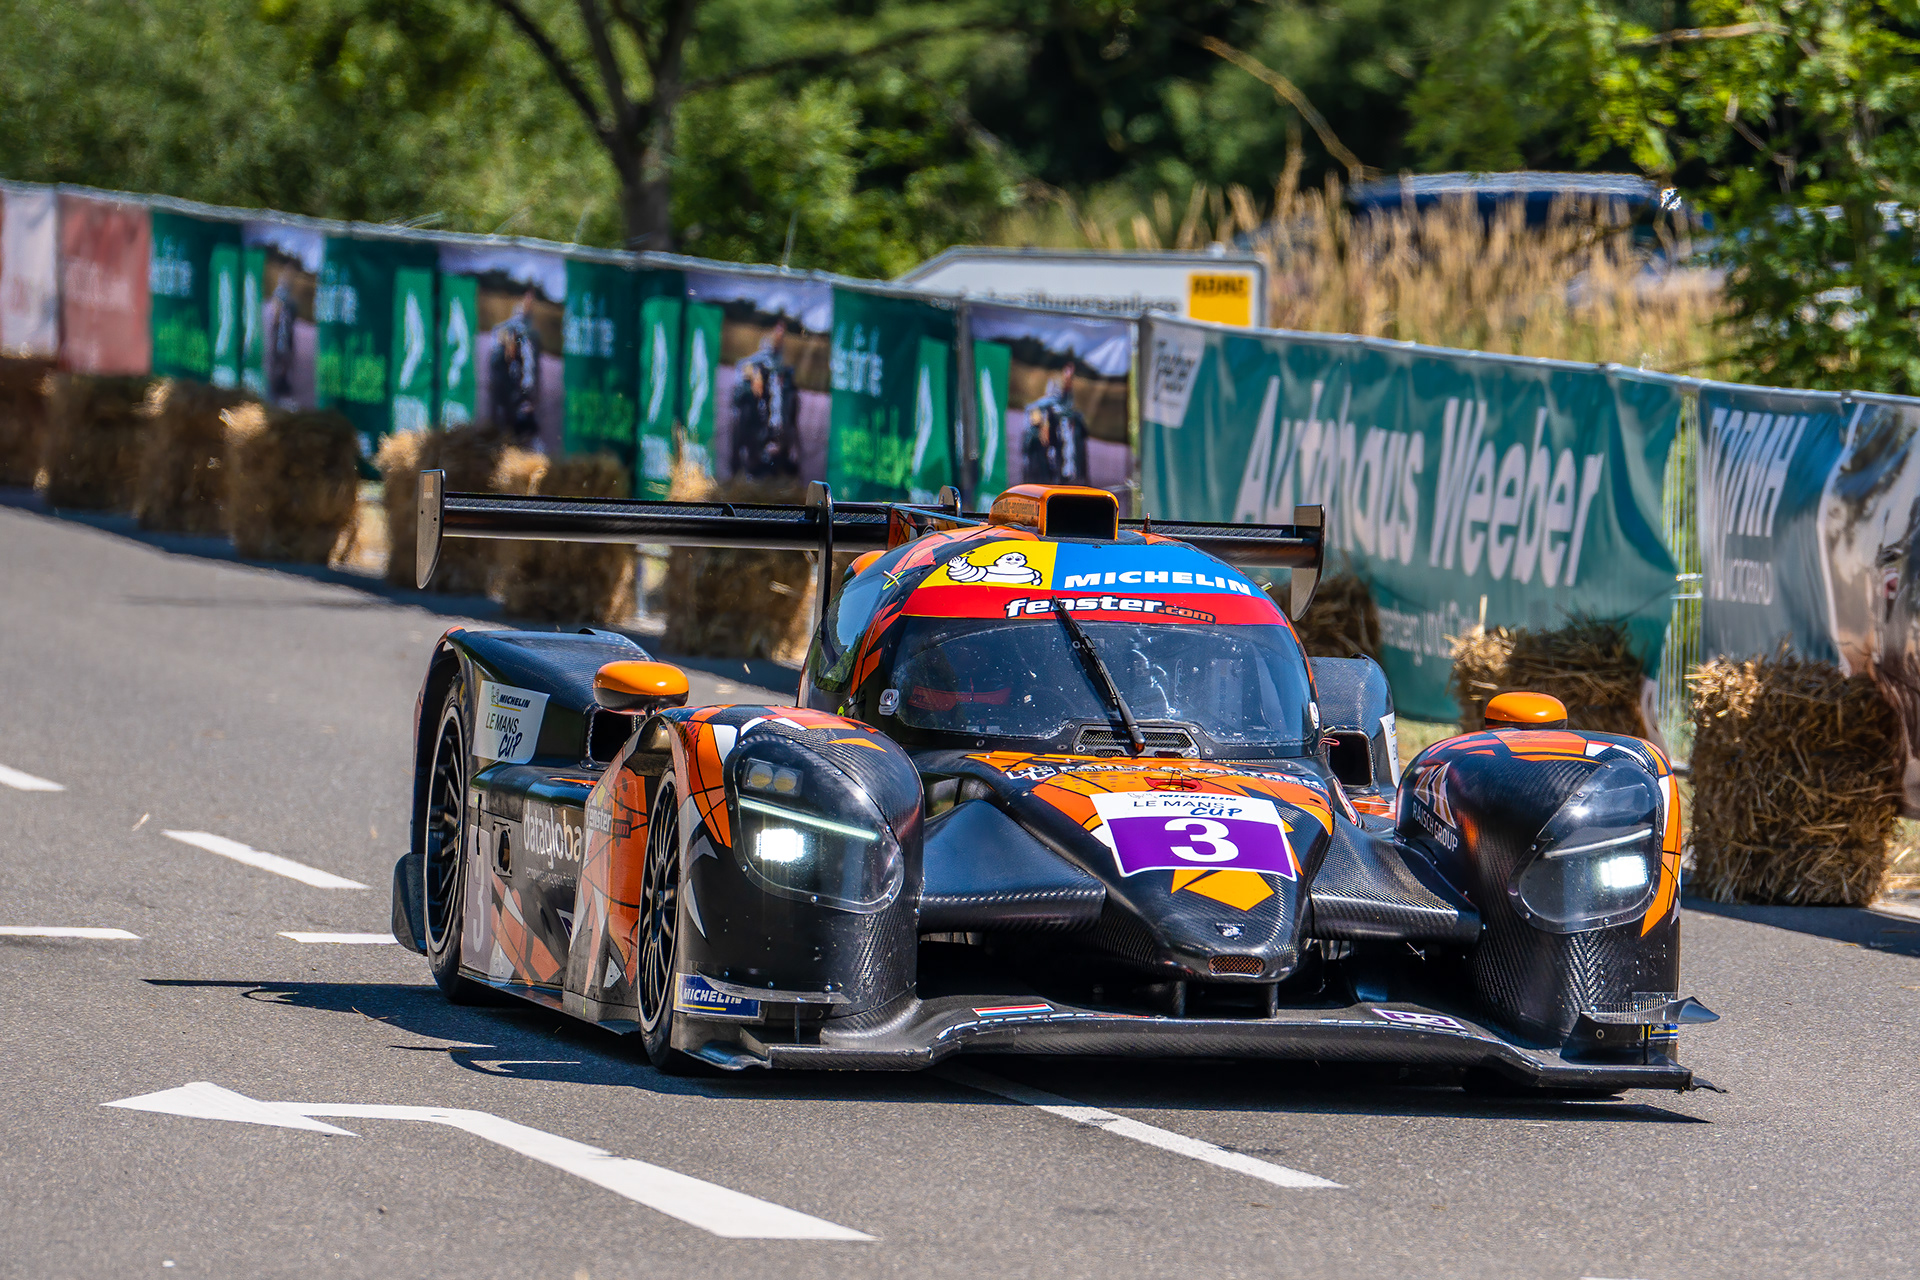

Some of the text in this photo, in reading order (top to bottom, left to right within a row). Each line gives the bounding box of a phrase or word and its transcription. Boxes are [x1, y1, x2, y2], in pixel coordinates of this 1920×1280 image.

[1428, 396, 1605, 589] Weeber
[1063, 570, 1252, 596] MICHELIN
[1004, 595, 1216, 623] fenster.com
[499, 693, 532, 709] MICHELIN
[485, 712, 520, 735] LE MANS
[498, 731, 523, 758] CUP
[1133, 800, 1225, 809] LE MANS
[1158, 793, 1238, 802] MICHELIN
[1189, 807, 1243, 817] CUP
[523, 799, 584, 870] datagloba
[1412, 800, 1458, 852] RAISCH GROUP
[1164, 817, 1240, 863] 3
